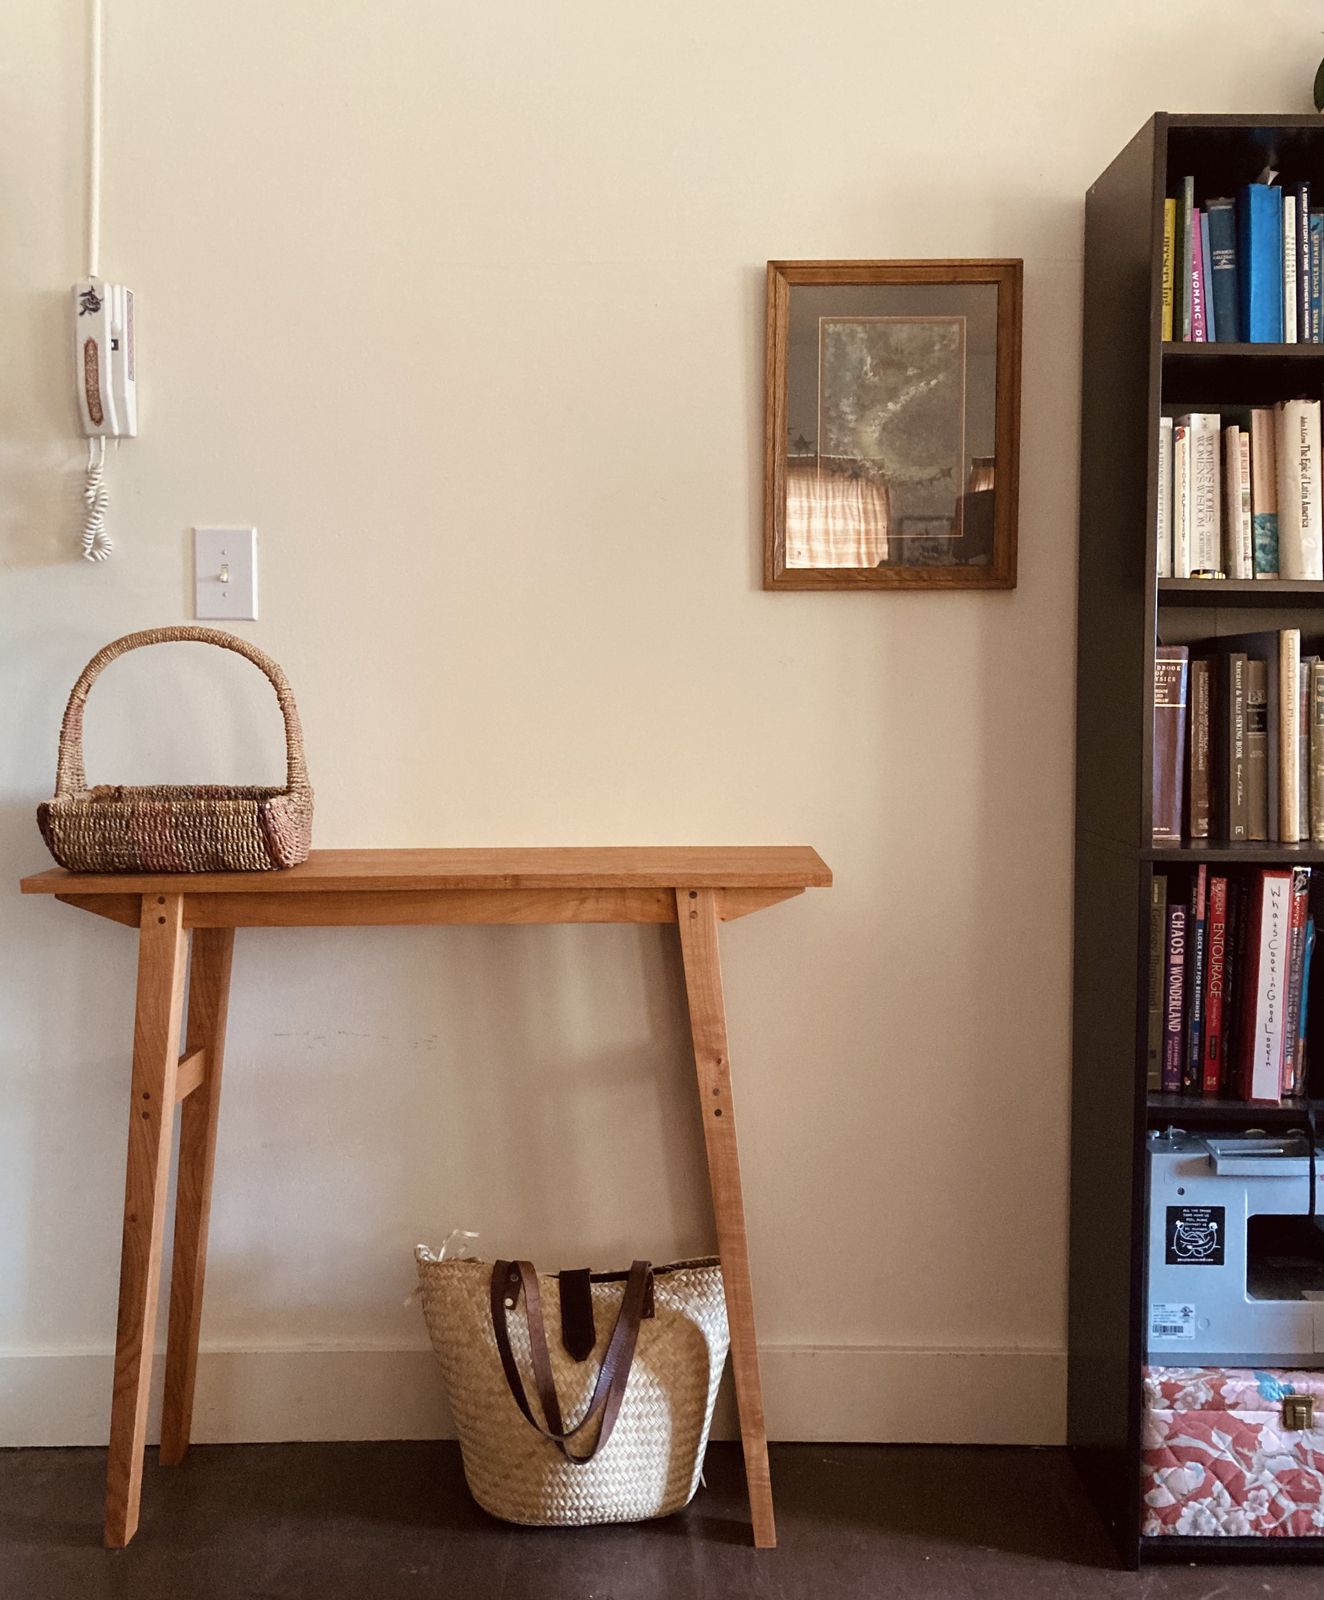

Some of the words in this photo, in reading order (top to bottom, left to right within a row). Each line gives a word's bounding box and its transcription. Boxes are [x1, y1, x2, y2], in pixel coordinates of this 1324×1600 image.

[1303, 244, 1309, 253] OF
[1299, 458, 1311, 472] Epic
[1300, 445, 1311, 457] The
[1197, 483, 1205, 528] WISDOM
[1301, 481, 1312, 499] Latin
[1301, 501, 1312, 528] America
[1171, 912, 1185, 954] CHAOS
[1210, 922, 1224, 998] ENTOURAGE
[1168, 966, 1184, 1032] WONDERLAND
[1193, 986, 1202, 1022] BEGINNERS
